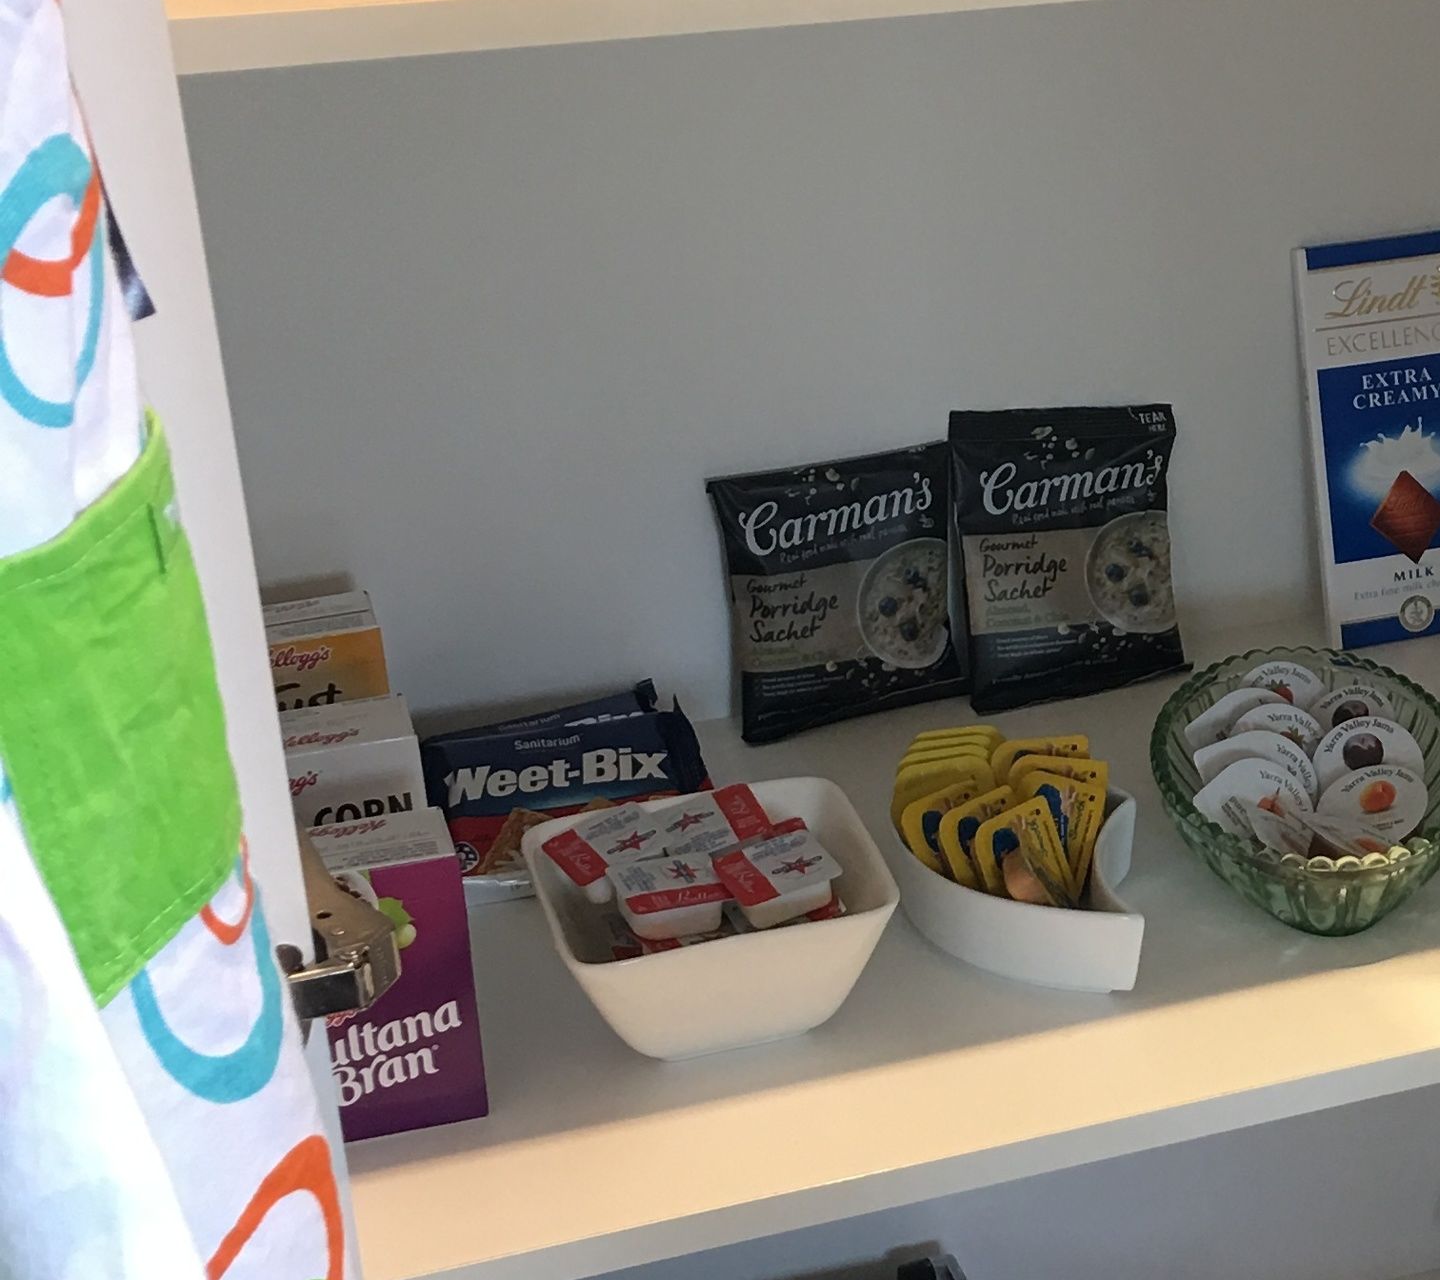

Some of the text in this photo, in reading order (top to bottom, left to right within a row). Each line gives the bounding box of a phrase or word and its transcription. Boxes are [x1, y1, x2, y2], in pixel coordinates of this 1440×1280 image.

[1325, 275, 1428, 319] Lindt
[1361, 366, 1433, 391] EXTRA
[1138, 410, 1167, 425] TEAR
[979, 449, 1165, 516] Carman's
[739, 471, 933, 557] Carman's
[979, 534, 1038, 554] Gourmet
[982, 555, 1068, 580] Porridge
[1393, 565, 1435, 582] MILK
[746, 573, 807, 595] Gourmet
[984, 578, 1054, 602] Sachet
[749, 591, 840, 622] Porridge
[749, 613, 822, 643] Sachet
[513, 733, 582, 752] Sanitarium
[1323, 718, 1396, 755] Yarra Valley Jams
[443, 747, 669, 808] Weet-Bix
[1364, 767, 1395, 779] Valley
[313, 791, 414, 828] CORN
[332, 1000, 463, 1070] ultana
